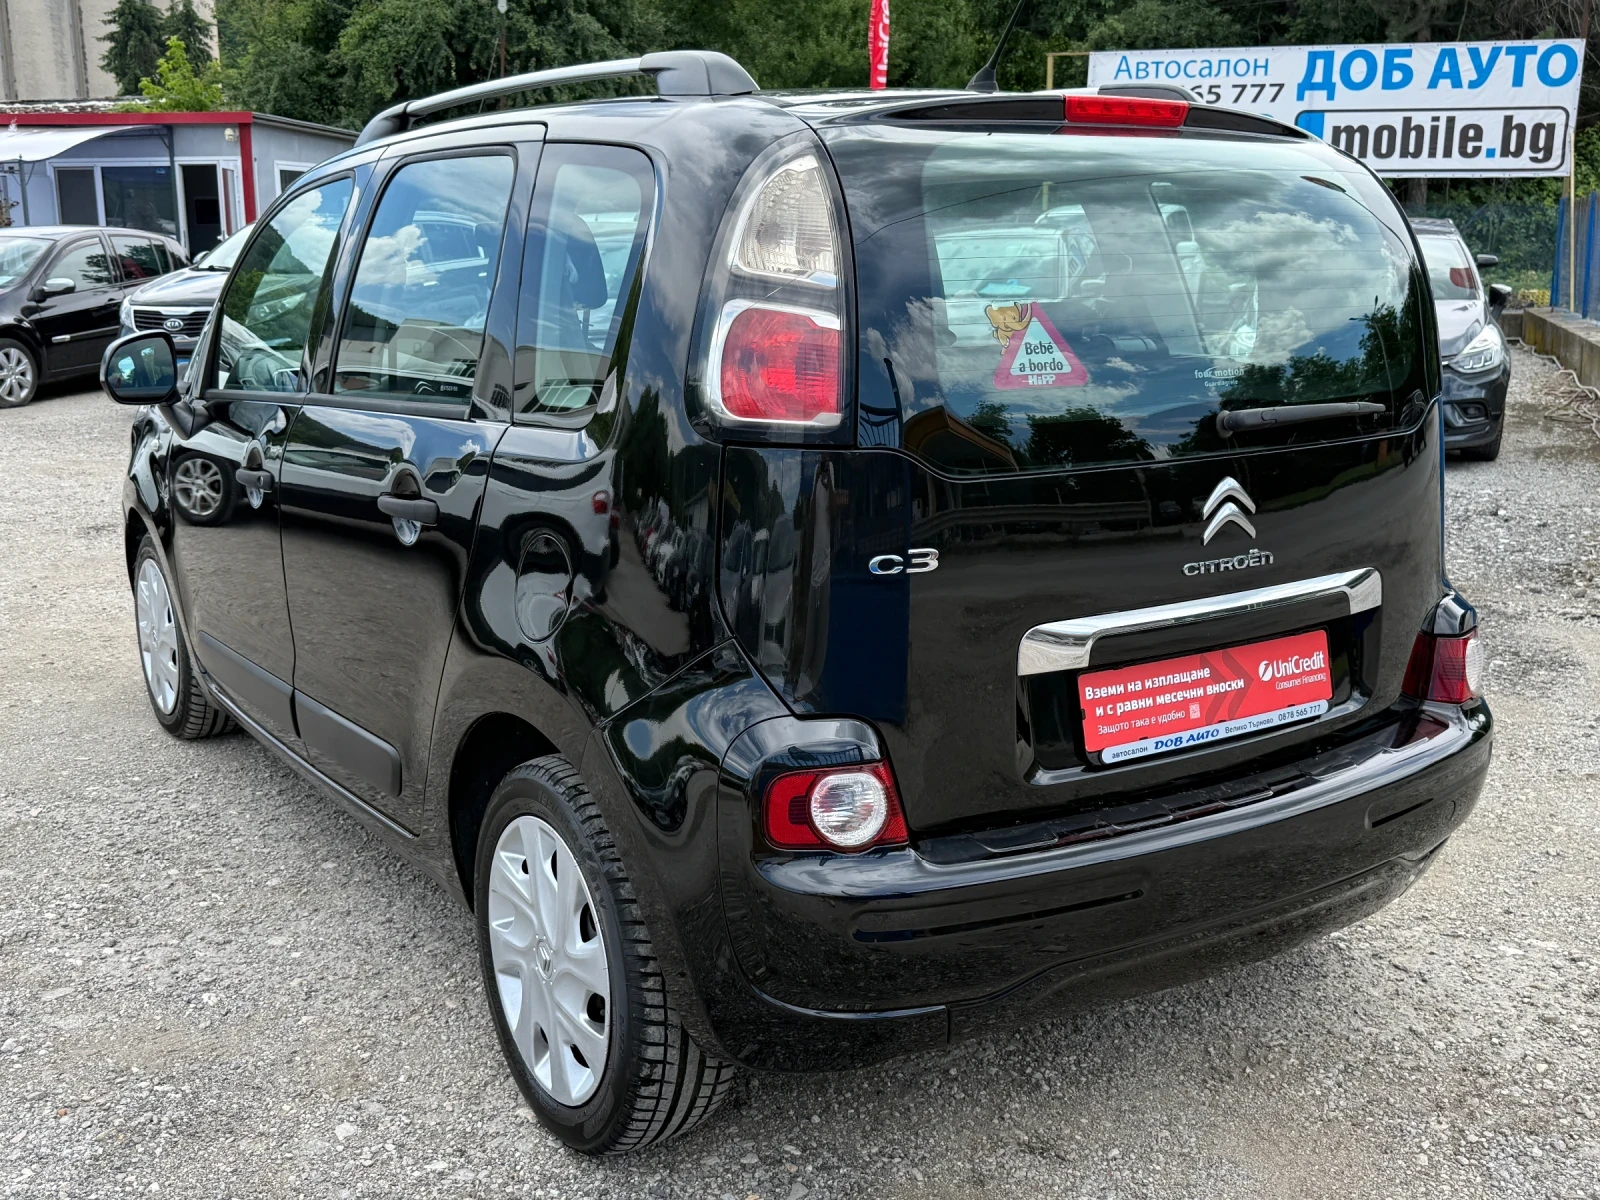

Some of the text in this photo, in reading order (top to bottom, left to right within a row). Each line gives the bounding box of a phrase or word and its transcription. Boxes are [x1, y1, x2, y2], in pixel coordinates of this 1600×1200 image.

[1113, 55, 1270, 80] Автосалон
[1296, 43, 1579, 102] ДОБ АУТО
[1181, 83, 1285, 104] 65 777
[1331, 114, 1556, 163] mobile.bg
[1024, 341, 1054, 355] Bebé
[1019, 357, 1064, 372] a bordo
[1194, 367, 1245, 379] four motion
[1028, 374, 1056, 385] HiPP
[868, 547, 940, 576] C3
[1273, 650, 1325, 678] UniCredit
[1085, 667, 1211, 700] Вземи на изплащане
[1275, 671, 1326, 690] Consumer Financing
[1095, 678, 1245, 717] и с равни месечни вноски
[1097, 710, 1186, 735] Защото така е удобно
[1111, 746, 1148, 759] автосалон
[1154, 736, 1183, 750] DOB
[1224, 723, 1248, 734] Велико
[1248, 718, 1274, 729] Търново
[1278, 711, 1294, 722] 0878
[1296, 707, 1308, 717] 565
[1309, 704, 1321, 714] 777
